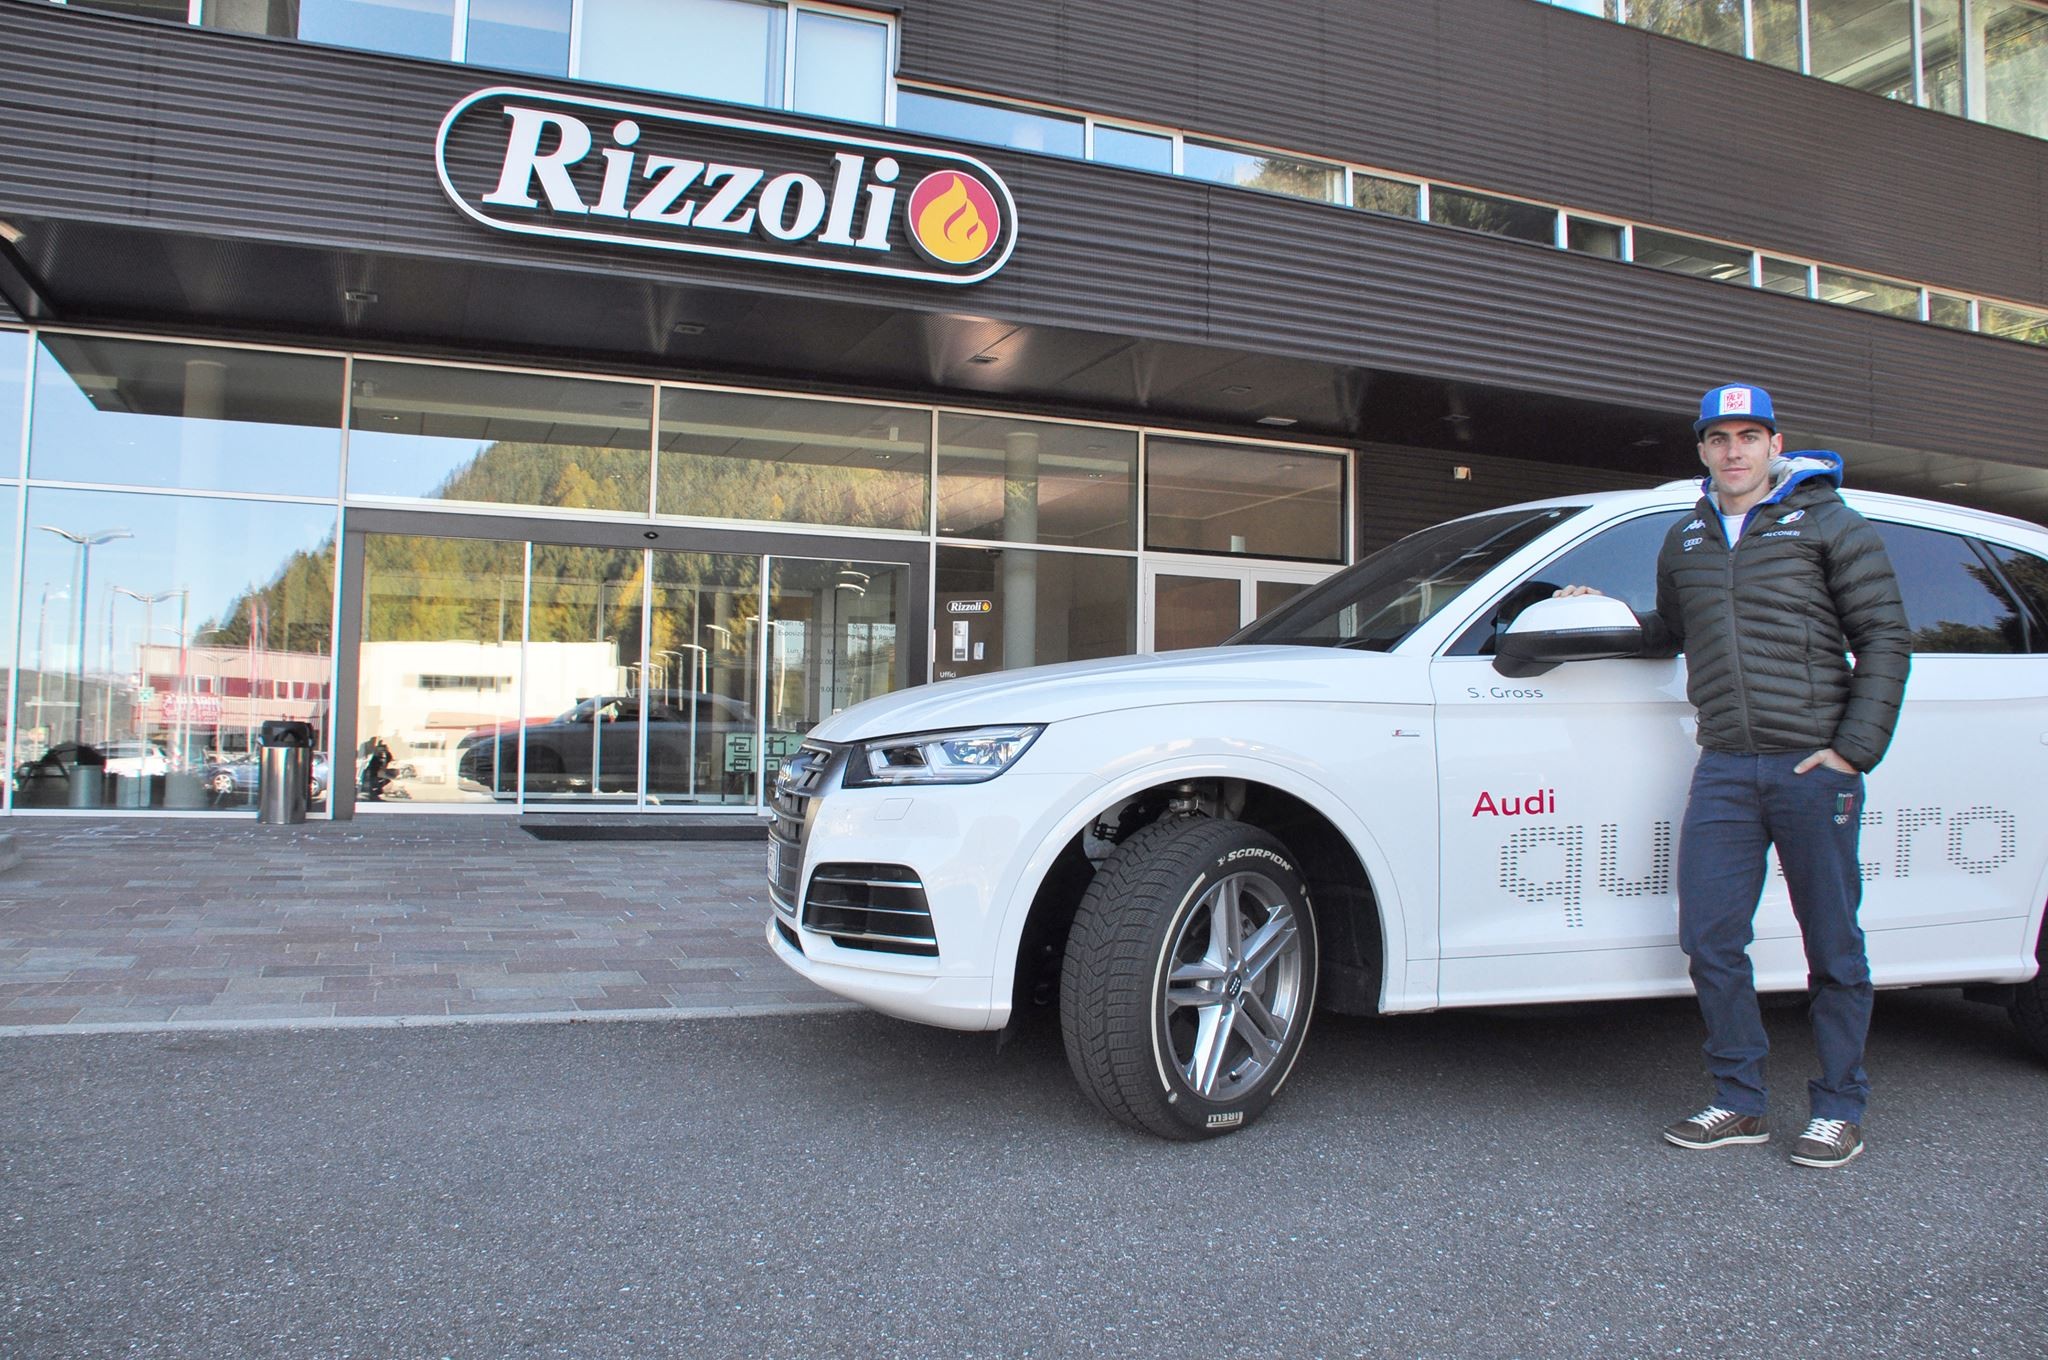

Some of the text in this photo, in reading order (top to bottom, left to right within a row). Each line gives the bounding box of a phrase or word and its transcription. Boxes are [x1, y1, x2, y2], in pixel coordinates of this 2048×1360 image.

[481, 105, 900, 252] Rizzoli
[950, 601, 982, 612] Rizzoli
[1467, 687, 1544, 699] S. Gross
[1472, 789, 1555, 817] Audi
[1227, 847, 1293, 871] SCORPION
[1499, 806, 2016, 928] quro
[1206, 1111, 1243, 1128] PIRELLI
